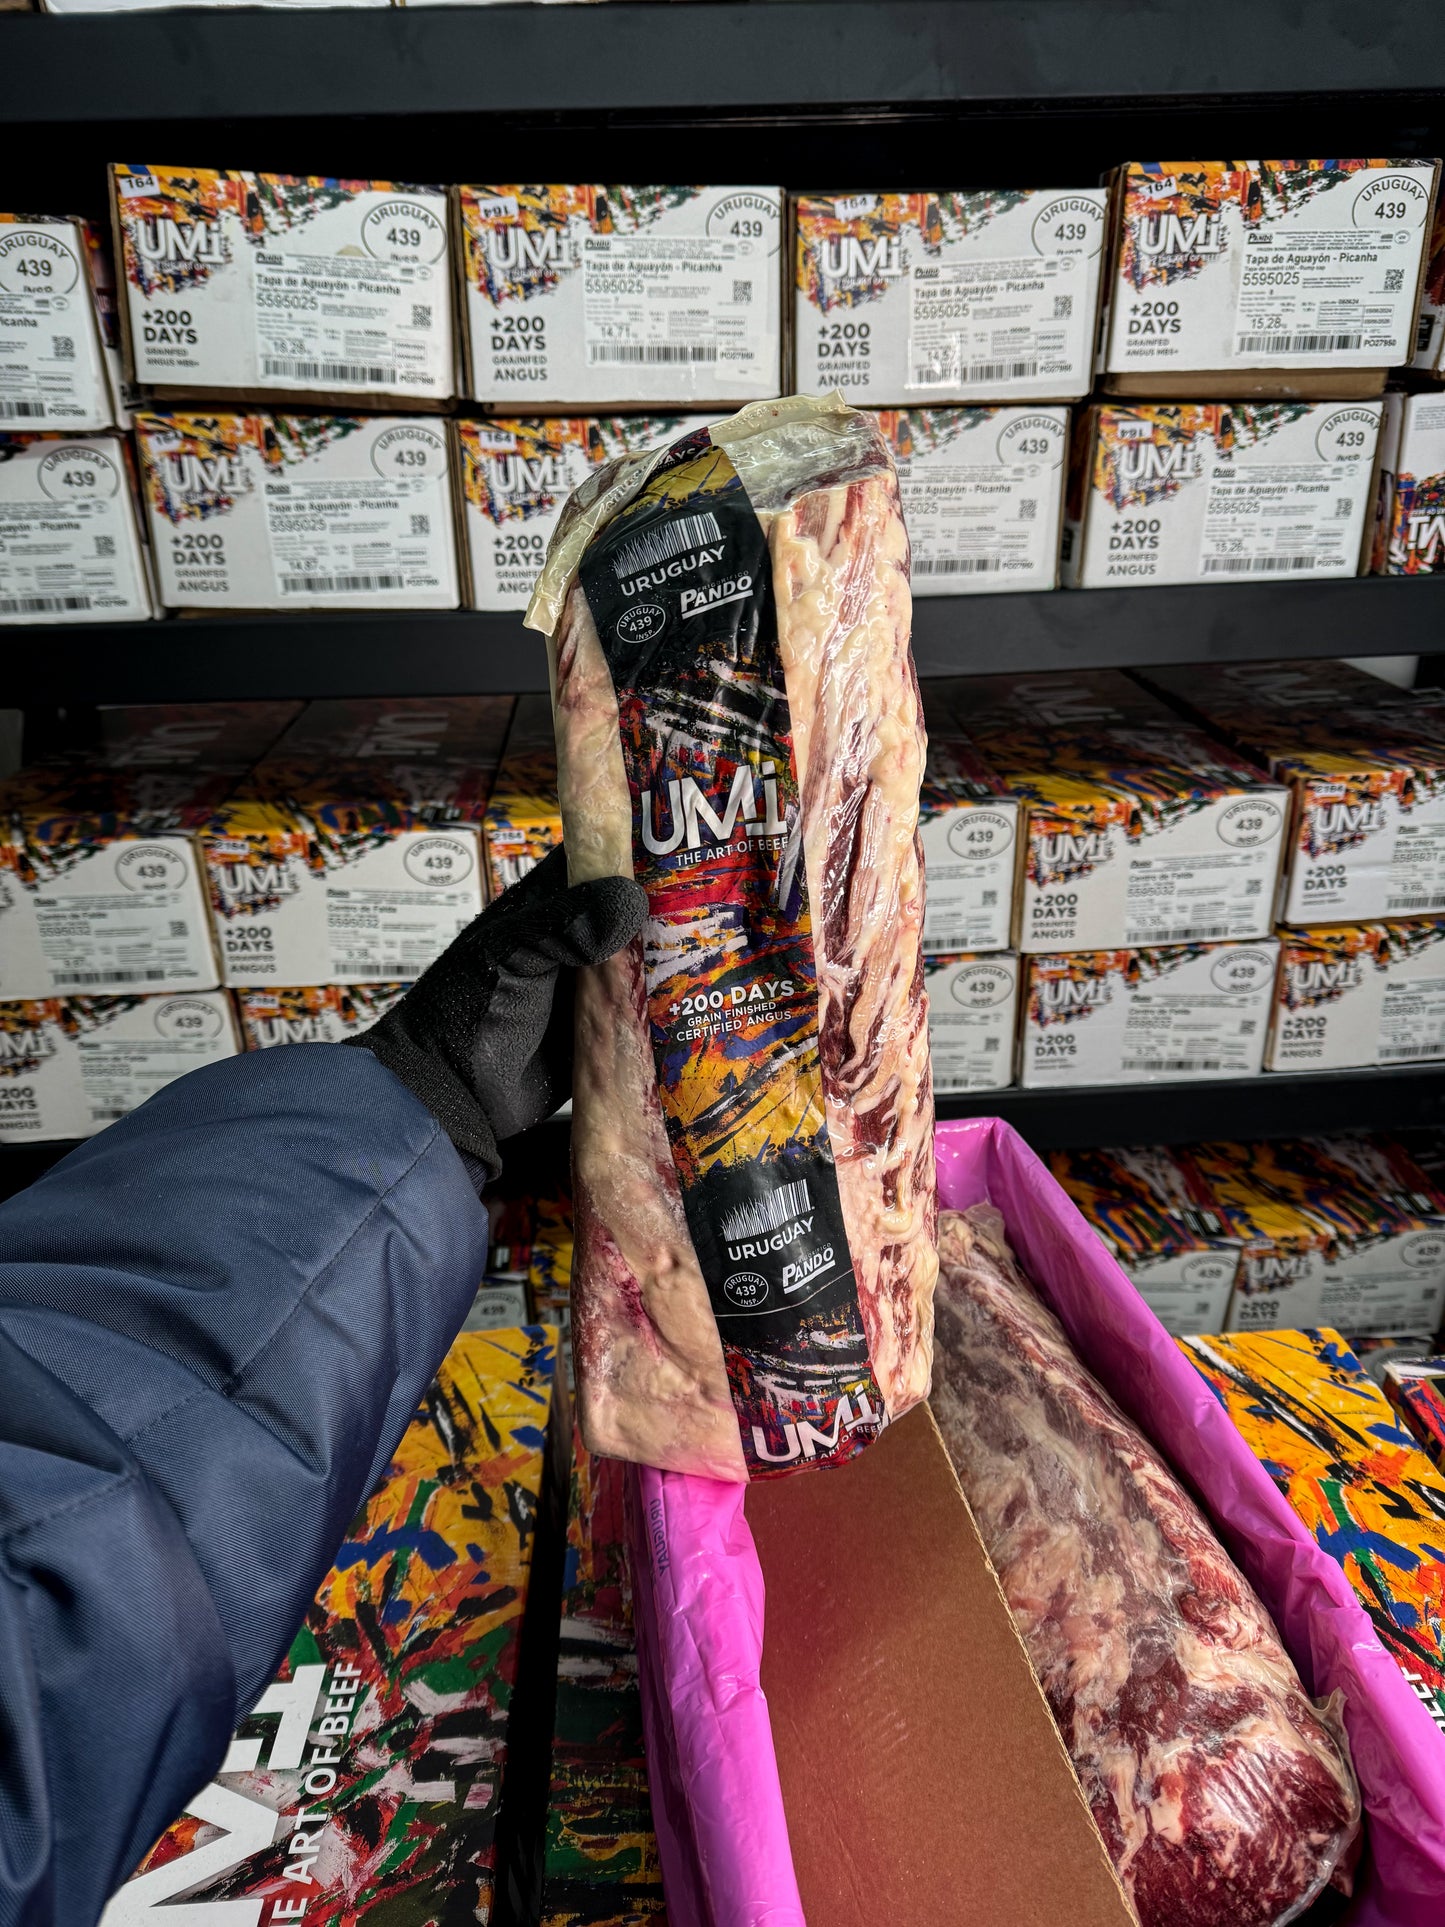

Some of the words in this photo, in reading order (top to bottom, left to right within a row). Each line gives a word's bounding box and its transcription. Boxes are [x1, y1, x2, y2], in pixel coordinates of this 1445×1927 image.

[126, 177, 154, 190] 164
[1146, 178, 1173, 194] 164
[1362, 178, 1426, 202] URUGUAY
[483, 206, 509, 217] 164
[714, 197, 780, 220] URUGUAY
[1041, 200, 1104, 224] URUGUAY
[1374, 202, 1406, 220] 439
[369, 206, 438, 233] URUGUAY
[730, 222, 762, 237] 439
[1055, 224, 1086, 241] 439
[387, 229, 421, 247] 439
[612, 262, 624, 271] de
[682, 261, 723, 272] Picanha
[1246, 254, 1268, 266] Tapa
[1271, 254, 1284, 262] de
[1287, 253, 1331, 265] Aguayón
[1338, 252, 1378, 262] Picanha
[17, 259, 52, 277] 439
[256, 274, 282, 286] Tapa
[285, 278, 298, 286] de
[358, 283, 401, 295] Picanha
[585, 279, 644, 294] 5595025
[1242, 272, 1300, 286] 5595025
[915, 288, 937, 300] Tapa
[940, 286, 952, 296] de
[1006, 281, 1044, 293] Picanha
[914, 304, 970, 320] 5595025
[1130, 301, 1179, 317] +200
[143, 310, 191, 326] +200
[490, 316, 545, 332] +200
[818, 322, 872, 339] +200
[1128, 320, 1182, 335] DAYS
[144, 328, 198, 344] DAYS
[492, 335, 546, 350] DAYS
[818, 342, 872, 357] DAYS
[494, 368, 548, 381] ANGUS
[818, 373, 870, 386] ANGUS
[1005, 419, 1066, 440] URUGUAY
[1325, 412, 1380, 432] URUGUAY
[378, 432, 442, 451] URUGUAY
[1018, 440, 1048, 455] 439
[1336, 432, 1365, 448] 439
[44, 450, 110, 472] URUGUAY
[394, 452, 426, 466] 439
[62, 471, 96, 487] 439
[1110, 520, 1161, 534] +200
[171, 534, 223, 549] +200
[493, 536, 543, 550] +200
[1110, 536, 1160, 550] DAYS
[172, 552, 226, 566] DAYS
[494, 552, 546, 567] DAYS
[620, 545, 726, 597] URUGUAY
[1106, 564, 1156, 576] ANGUS
[177, 580, 229, 592] ANGUS
[698, 570, 750, 592] FRIGORIFICO
[680, 575, 752, 614] PANDO
[619, 605, 662, 628] URUGUAY
[628, 616, 653, 634] 439
[635, 629, 656, 641] INSP.
[1236, 818, 1262, 832] 439
[966, 830, 994, 844] 439
[676, 852, 702, 867] THE
[706, 844, 732, 861] ART
[737, 841, 755, 854] OF
[758, 836, 789, 851] BEEF
[425, 856, 452, 869] 439
[137, 865, 166, 878] 439
[1306, 865, 1346, 878] +200
[1304, 878, 1348, 890] DAYS
[1034, 894, 1078, 907] +200
[1032, 908, 1078, 920] DAYS
[224, 928, 272, 940] +200
[1031, 929, 1076, 940] ANGUS
[226, 941, 274, 952] DAYS
[230, 964, 277, 974] ANGUS
[1230, 966, 1256, 979] 439
[969, 982, 995, 994] 439
[669, 990, 724, 1016] +200
[730, 980, 795, 1005] DAYS
[688, 1010, 722, 1027] GRAIN
[725, 1002, 776, 1020] FINISHED
[676, 1020, 742, 1042] CERTIFIED
[746, 1010, 792, 1027] ANGUS
[1284, 1017, 1327, 1028] +200
[1036, 1034, 1075, 1046] +200
[1282, 1030, 1326, 1040] DAYS
[1035, 1046, 1076, 1057] DAYS
[0, 1087, 34, 1098] 200
[728, 1216, 814, 1262] URUGUAY
[782, 1248, 834, 1288] PANDO
[726, 1276, 766, 1290] URUGUAY
[735, 1284, 757, 1297] 439
[740, 1298, 759, 1306] INSP.
[1240, 1311, 1278, 1320] DAYS
[820, 1443, 840, 1461] ART
[842, 1431, 854, 1444] OF
[318, 1662, 362, 1736] BEEF
[304, 1747, 342, 1795] OF
[282, 1806, 329, 1886] ART
